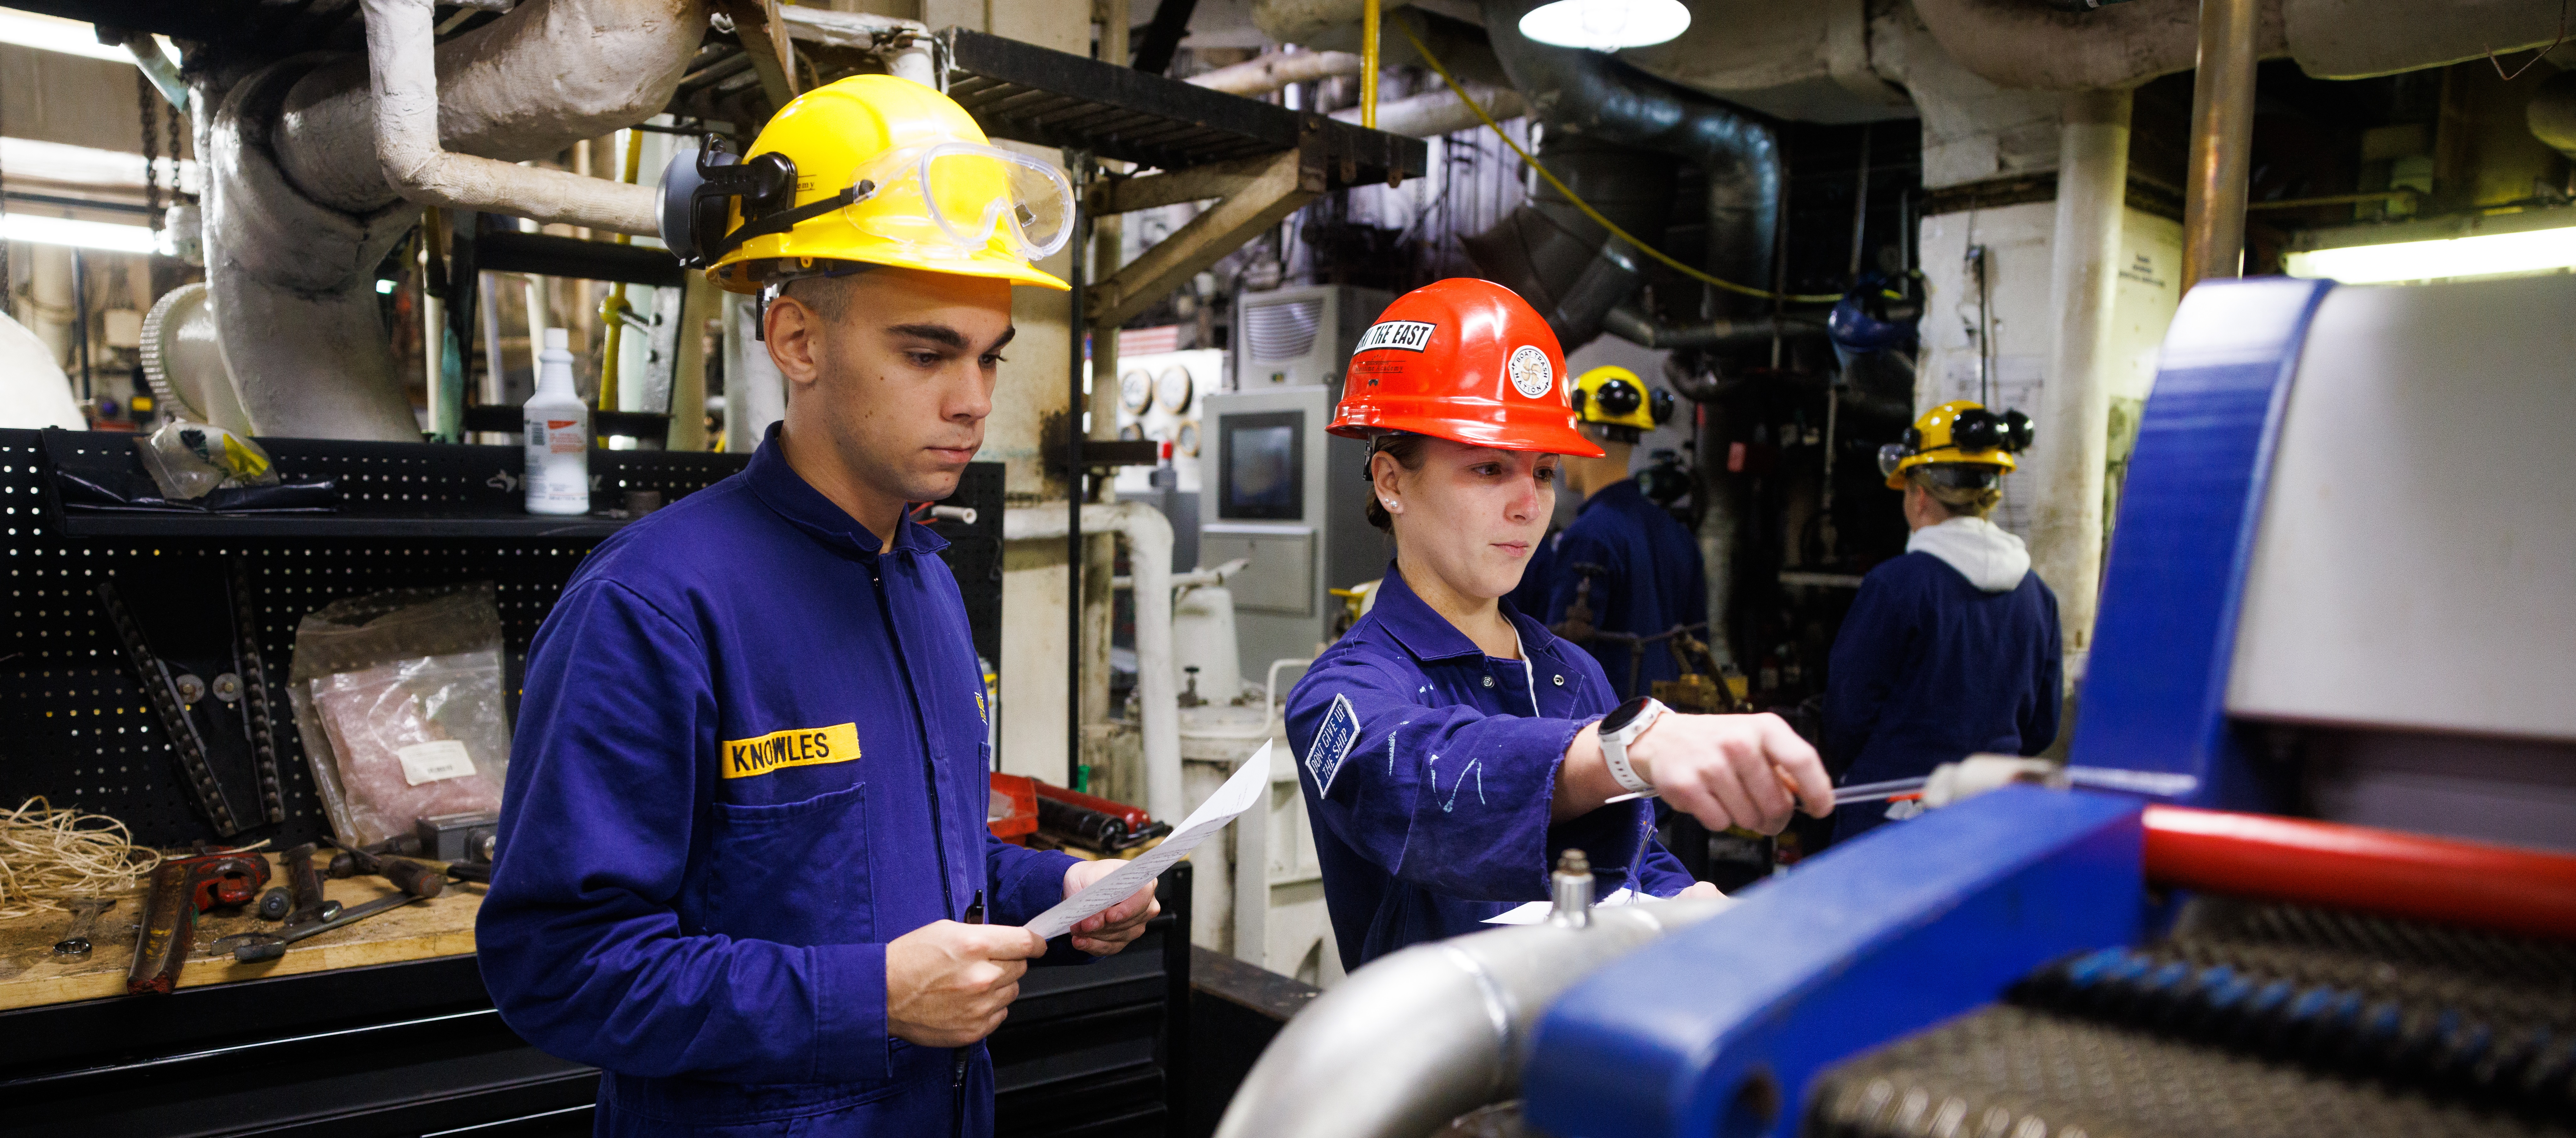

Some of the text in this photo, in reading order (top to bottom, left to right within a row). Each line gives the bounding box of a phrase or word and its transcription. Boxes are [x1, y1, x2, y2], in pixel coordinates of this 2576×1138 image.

[1371, 325, 1393, 345] THE
[1392, 325, 1430, 346] EAST
[1516, 351, 1548, 378] BOAT TRASH
[1515, 373, 1541, 393] NATION
[1322, 718, 1338, 748] GIVE
[1334, 704, 1345, 723] UP
[732, 732, 830, 772] KNOWLES
[1322, 728, 1349, 779] THE SHIP
